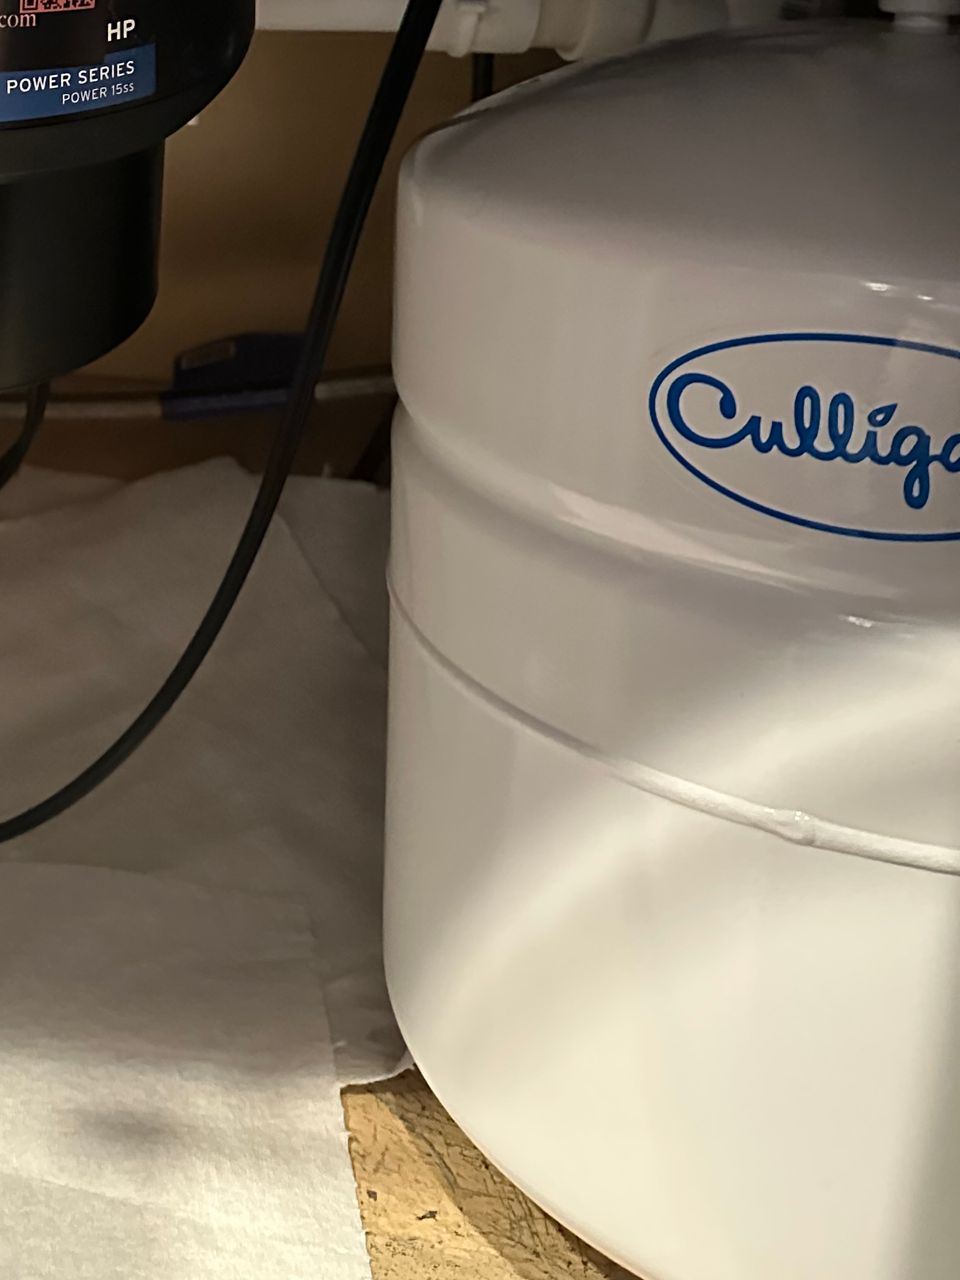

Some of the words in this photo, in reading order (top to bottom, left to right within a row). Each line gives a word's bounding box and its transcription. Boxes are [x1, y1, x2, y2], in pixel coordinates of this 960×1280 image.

[107, 18, 136, 42] HP
[6, 72, 72, 95] POWER
[78, 60, 136, 85] SERIES
[61, 86, 108, 105] POWER
